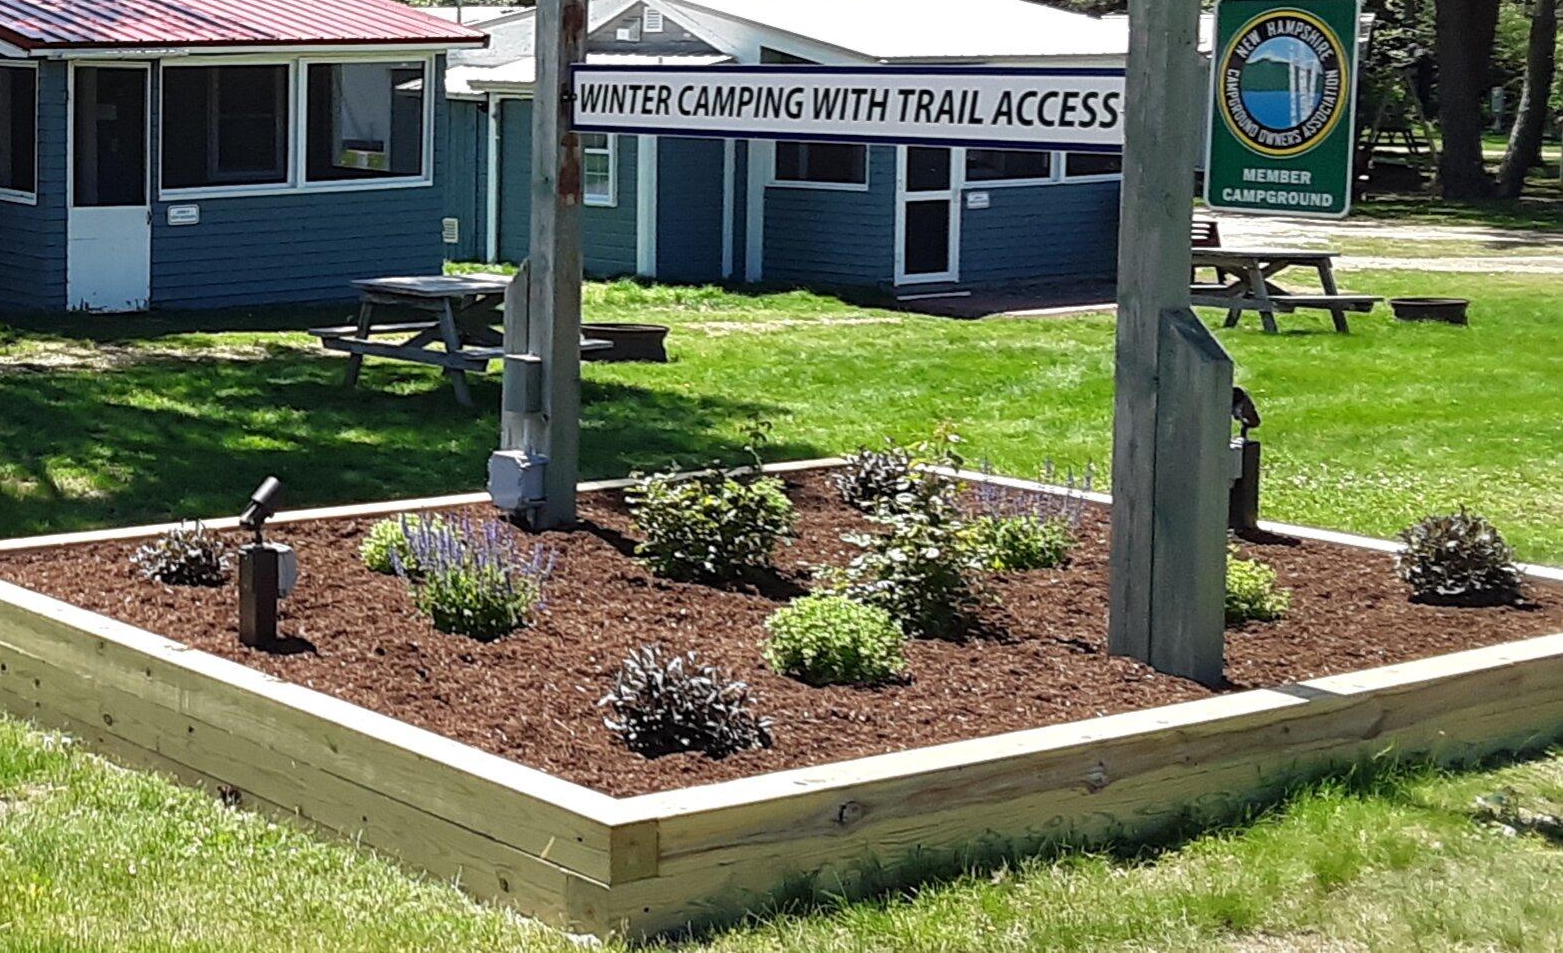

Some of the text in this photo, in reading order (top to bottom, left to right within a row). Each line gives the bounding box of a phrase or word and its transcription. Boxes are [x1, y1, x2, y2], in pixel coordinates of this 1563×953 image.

[1235, 20, 1335, 61] NEW HAMPSHIRE
[579, 83, 1121, 129] WINTER CAMPING WITH TRAIL ACCESS
[1226, 68, 1340, 147] CAMPGROUND OWNERS ASSOCIATION
[1242, 168, 1312, 185] MEMBER
[1221, 188, 1334, 207] CAMPGROUND
